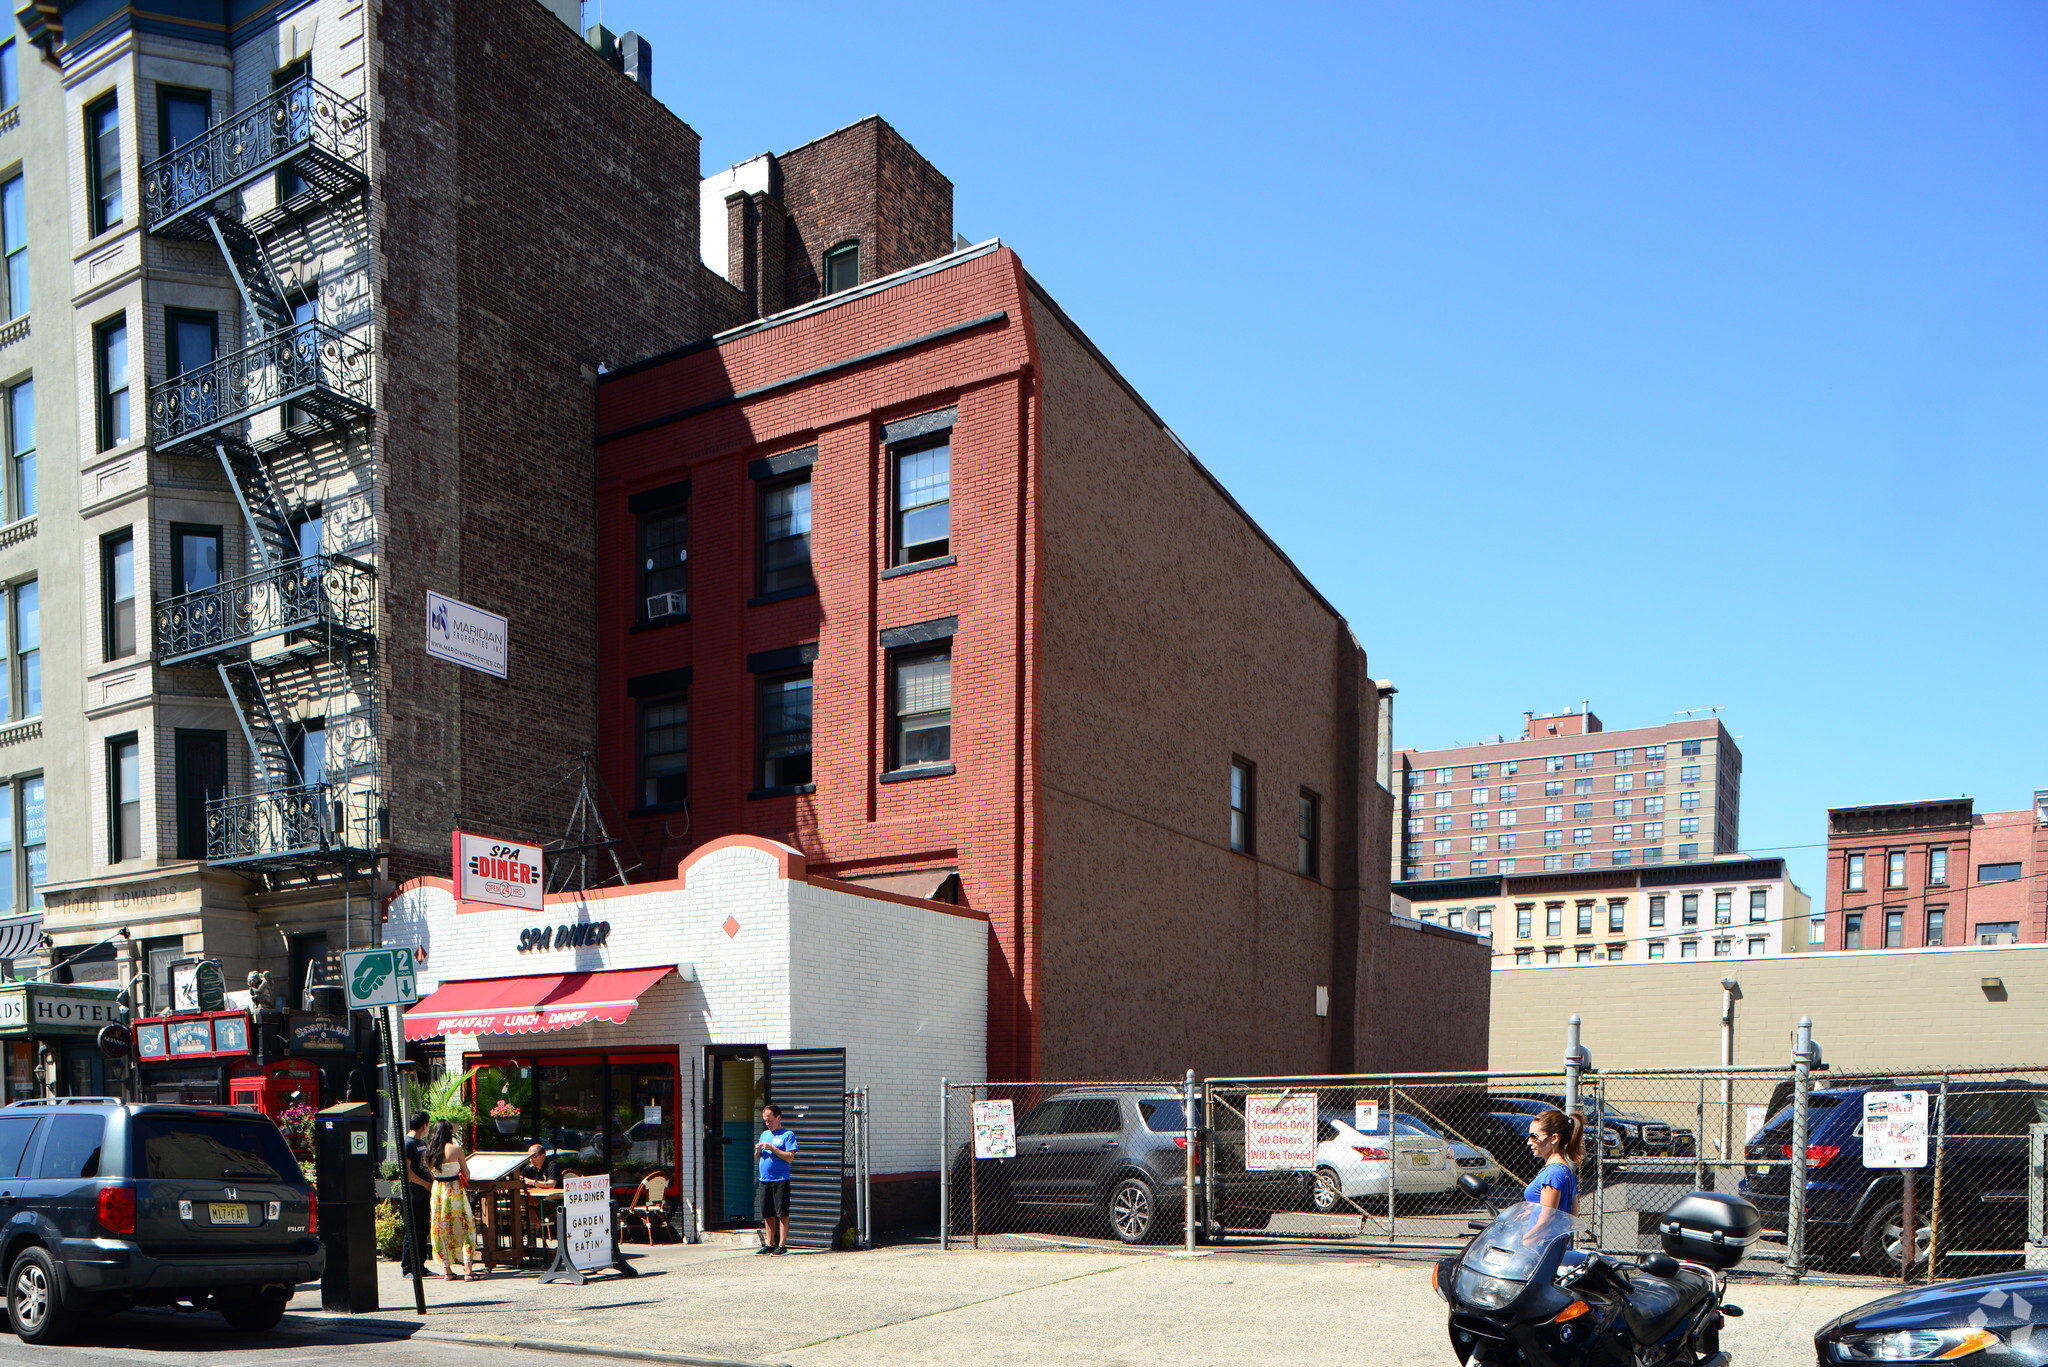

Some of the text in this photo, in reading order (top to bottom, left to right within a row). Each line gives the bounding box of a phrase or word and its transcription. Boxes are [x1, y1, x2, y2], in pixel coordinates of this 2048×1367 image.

[453, 619, 503, 646] MARIDIAN
[453, 631, 489, 649] PROPERTIES
[489, 844, 521, 861] SPA
[478, 855, 533, 885] DINER
[487, 883, 500, 893] OPEN
[501, 883, 511, 895] 24
[62, 885, 178, 915] HOTEL EDWARDS
[516, 920, 612, 954] SPA DINER
[396, 950, 410, 972] 2
[37, 1001, 118, 1022] HOTEL
[436, 1010, 589, 1031] BREAKFAST LUNCH DINNER
[170, 1025, 209, 1044] SCOTLAND
[294, 1022, 351, 1039] SCOTLAND
[1291, 1105, 1307, 1114] For
[1252, 1120, 1310, 1132] Tenants Only
[356, 1137, 364, 1148] P
[1258, 1135, 1303, 1145] All Others
[1250, 1149, 1311, 1160] Will Be Towed
[569, 1190, 605, 1204] SPA DINER
[572, 1215, 605, 1229] GARDEN
[583, 1228, 593, 1239] OF
